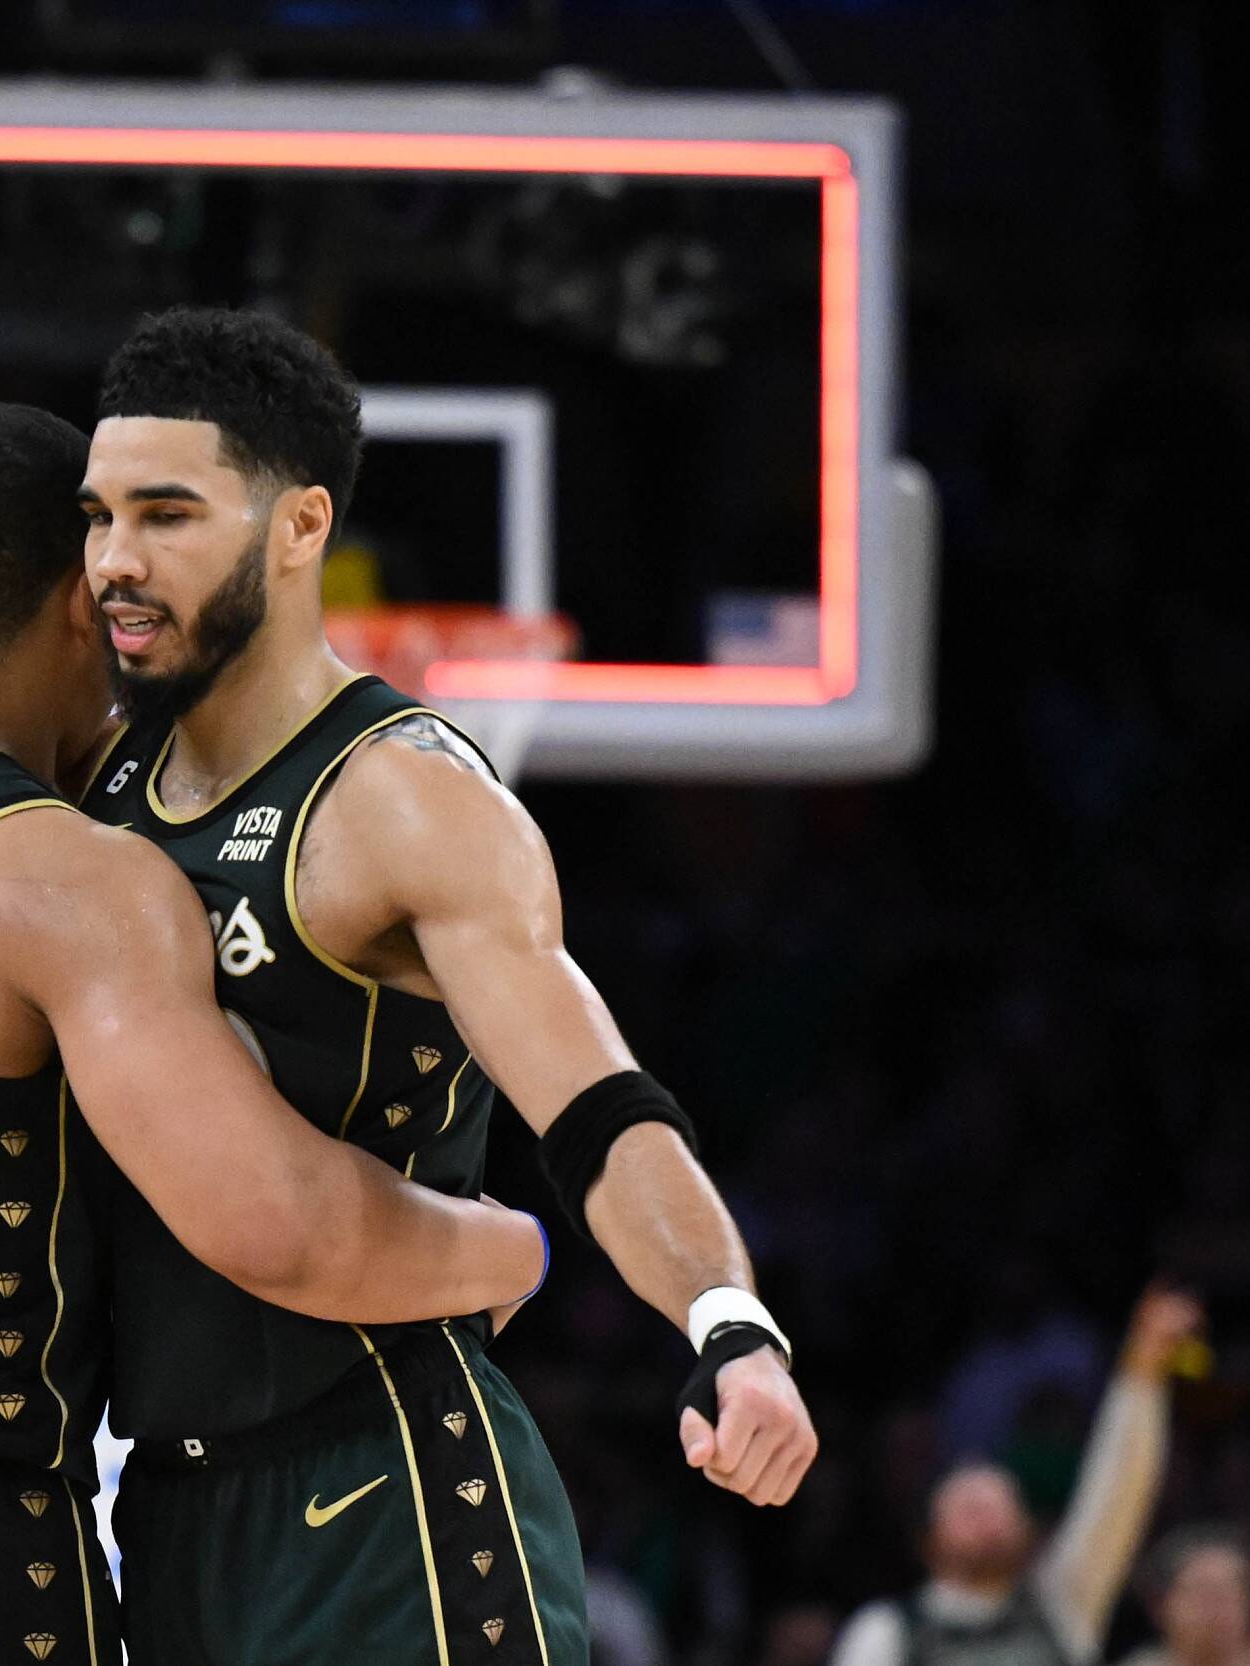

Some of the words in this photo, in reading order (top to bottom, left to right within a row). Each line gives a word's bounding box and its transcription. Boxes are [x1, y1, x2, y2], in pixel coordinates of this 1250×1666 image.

[105, 759, 139, 795] 6
[233, 806, 283, 838] VISTA
[216, 839, 274, 862] PRINT
